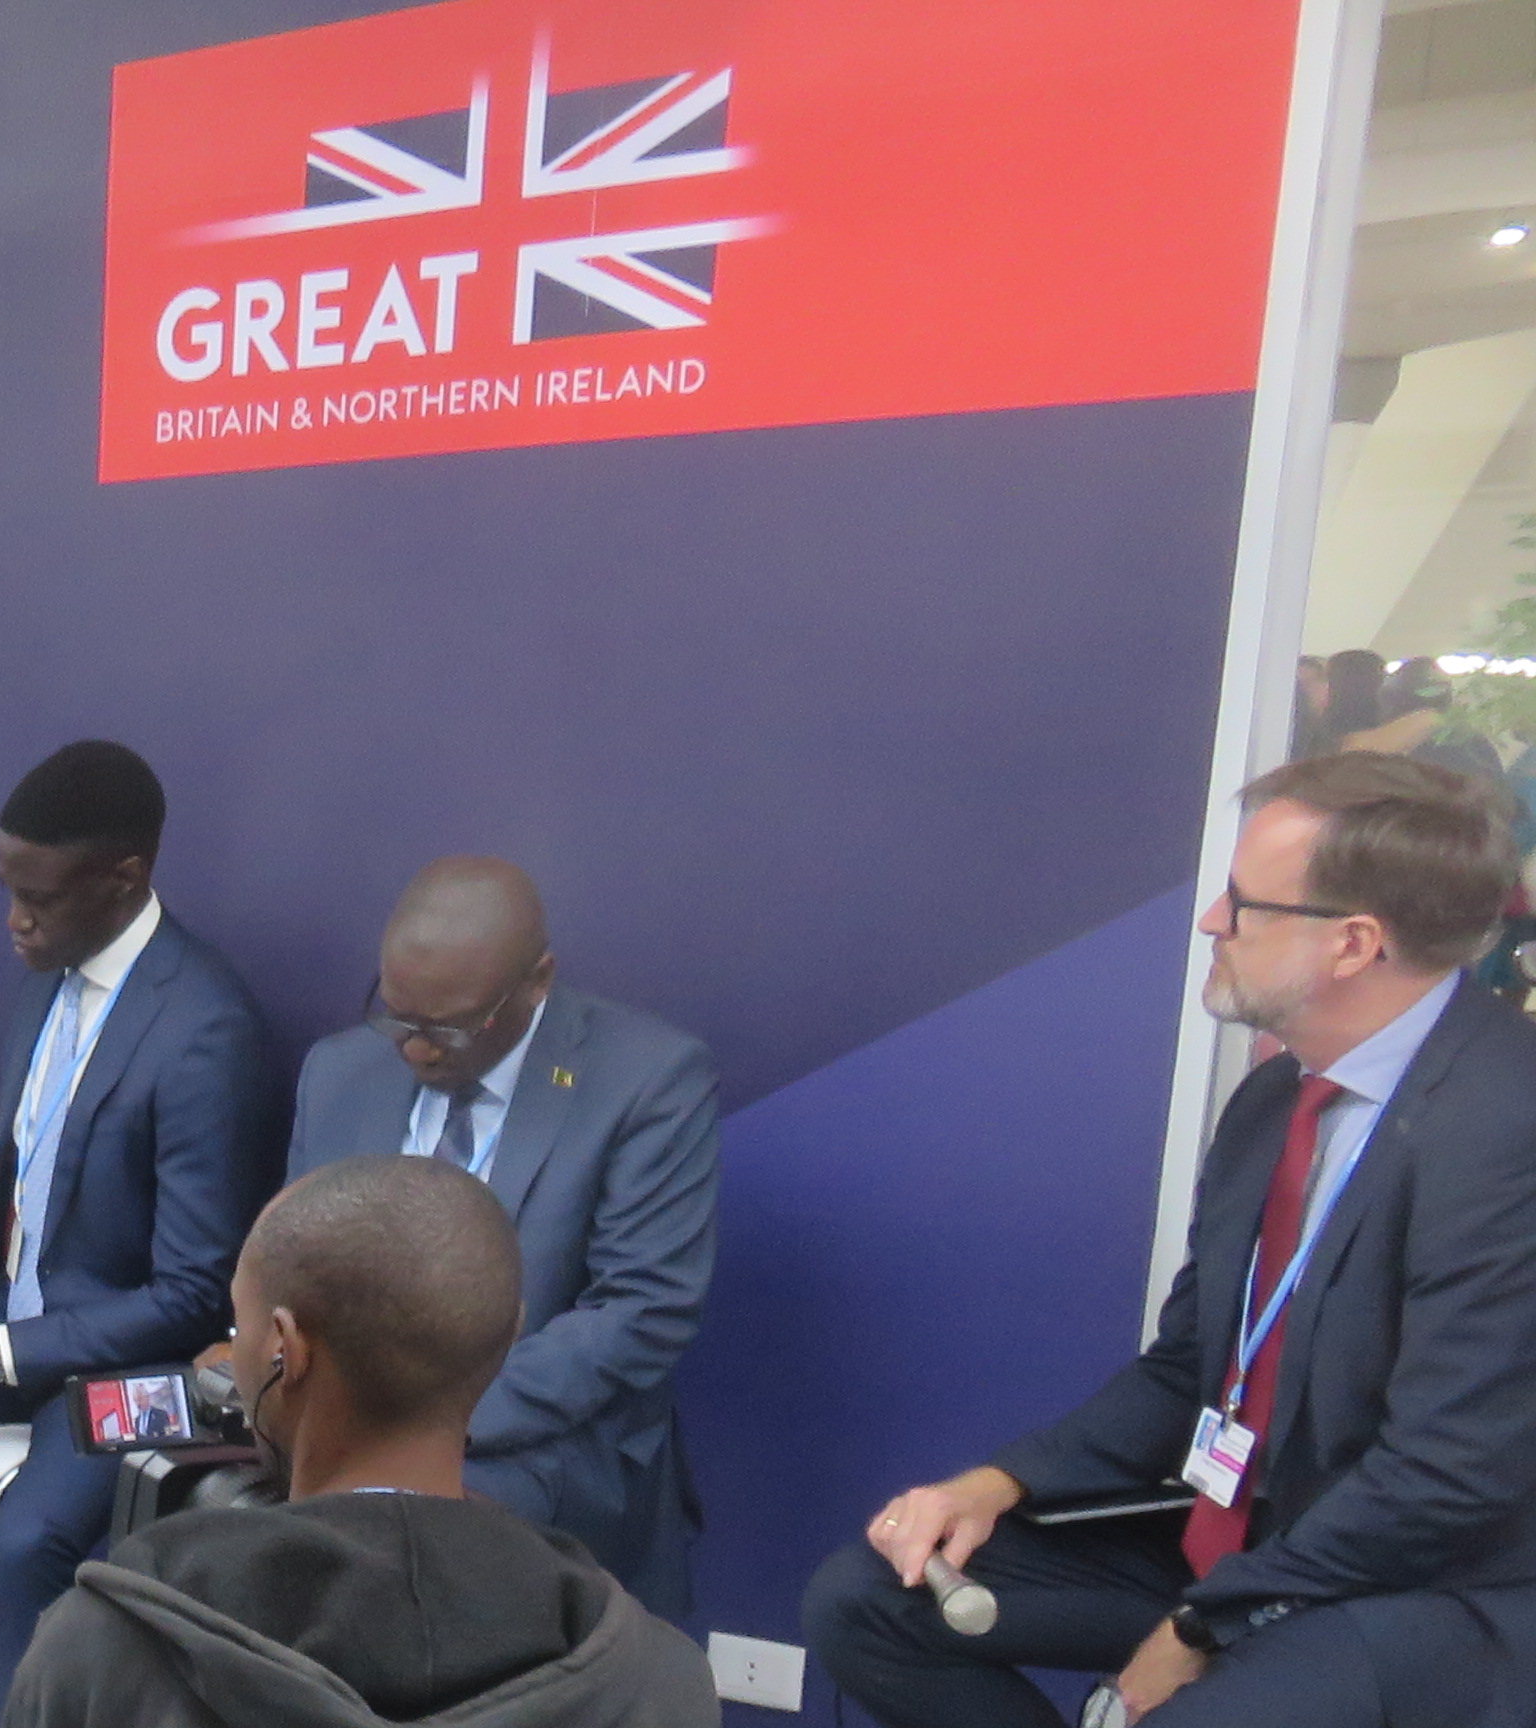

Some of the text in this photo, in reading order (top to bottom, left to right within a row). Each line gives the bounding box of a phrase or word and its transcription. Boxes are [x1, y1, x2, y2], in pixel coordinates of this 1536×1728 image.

[154, 249, 479, 383] GREAT
[155, 359, 706, 444] BRITAIN & NORTHERN IRELAND
